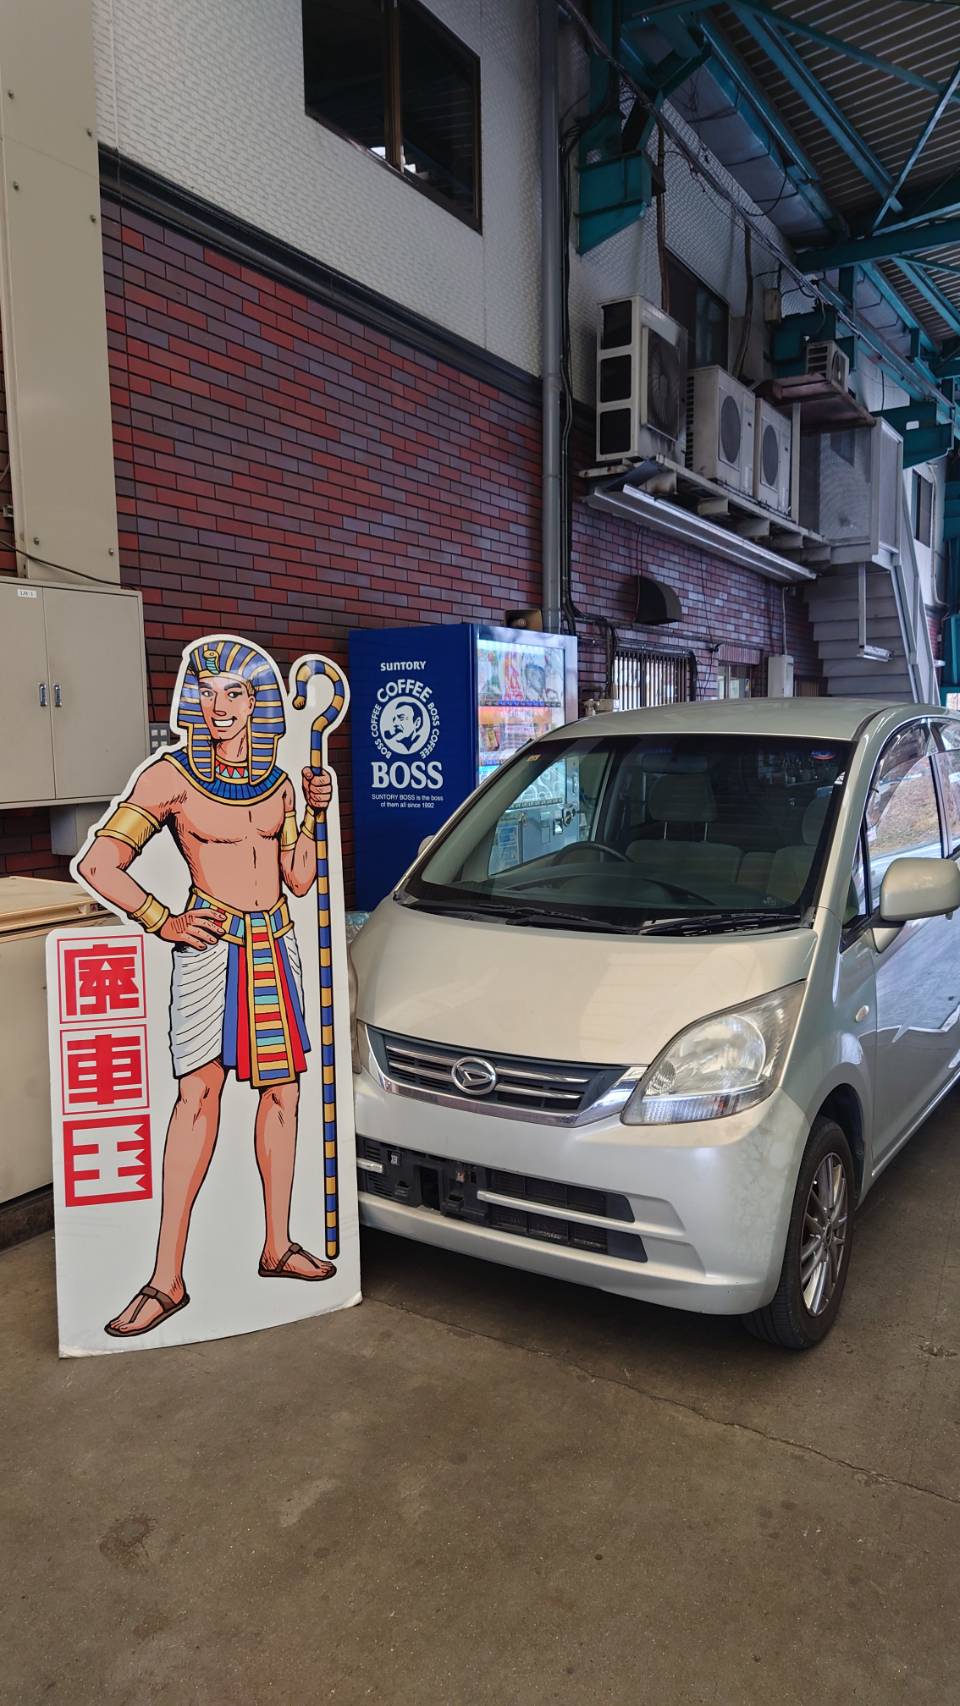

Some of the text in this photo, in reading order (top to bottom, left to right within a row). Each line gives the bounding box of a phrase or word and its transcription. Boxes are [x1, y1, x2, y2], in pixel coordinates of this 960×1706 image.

[380, 661, 426, 672] SUNTORY
[377, 679, 433, 703] COFFEE
[371, 704, 392, 759] BOSS COFFEE
[419, 702, 440, 759] BOSS COFFEE
[371, 761, 443, 789] BOSS
[60, 938, 151, 1204] 廃車王
